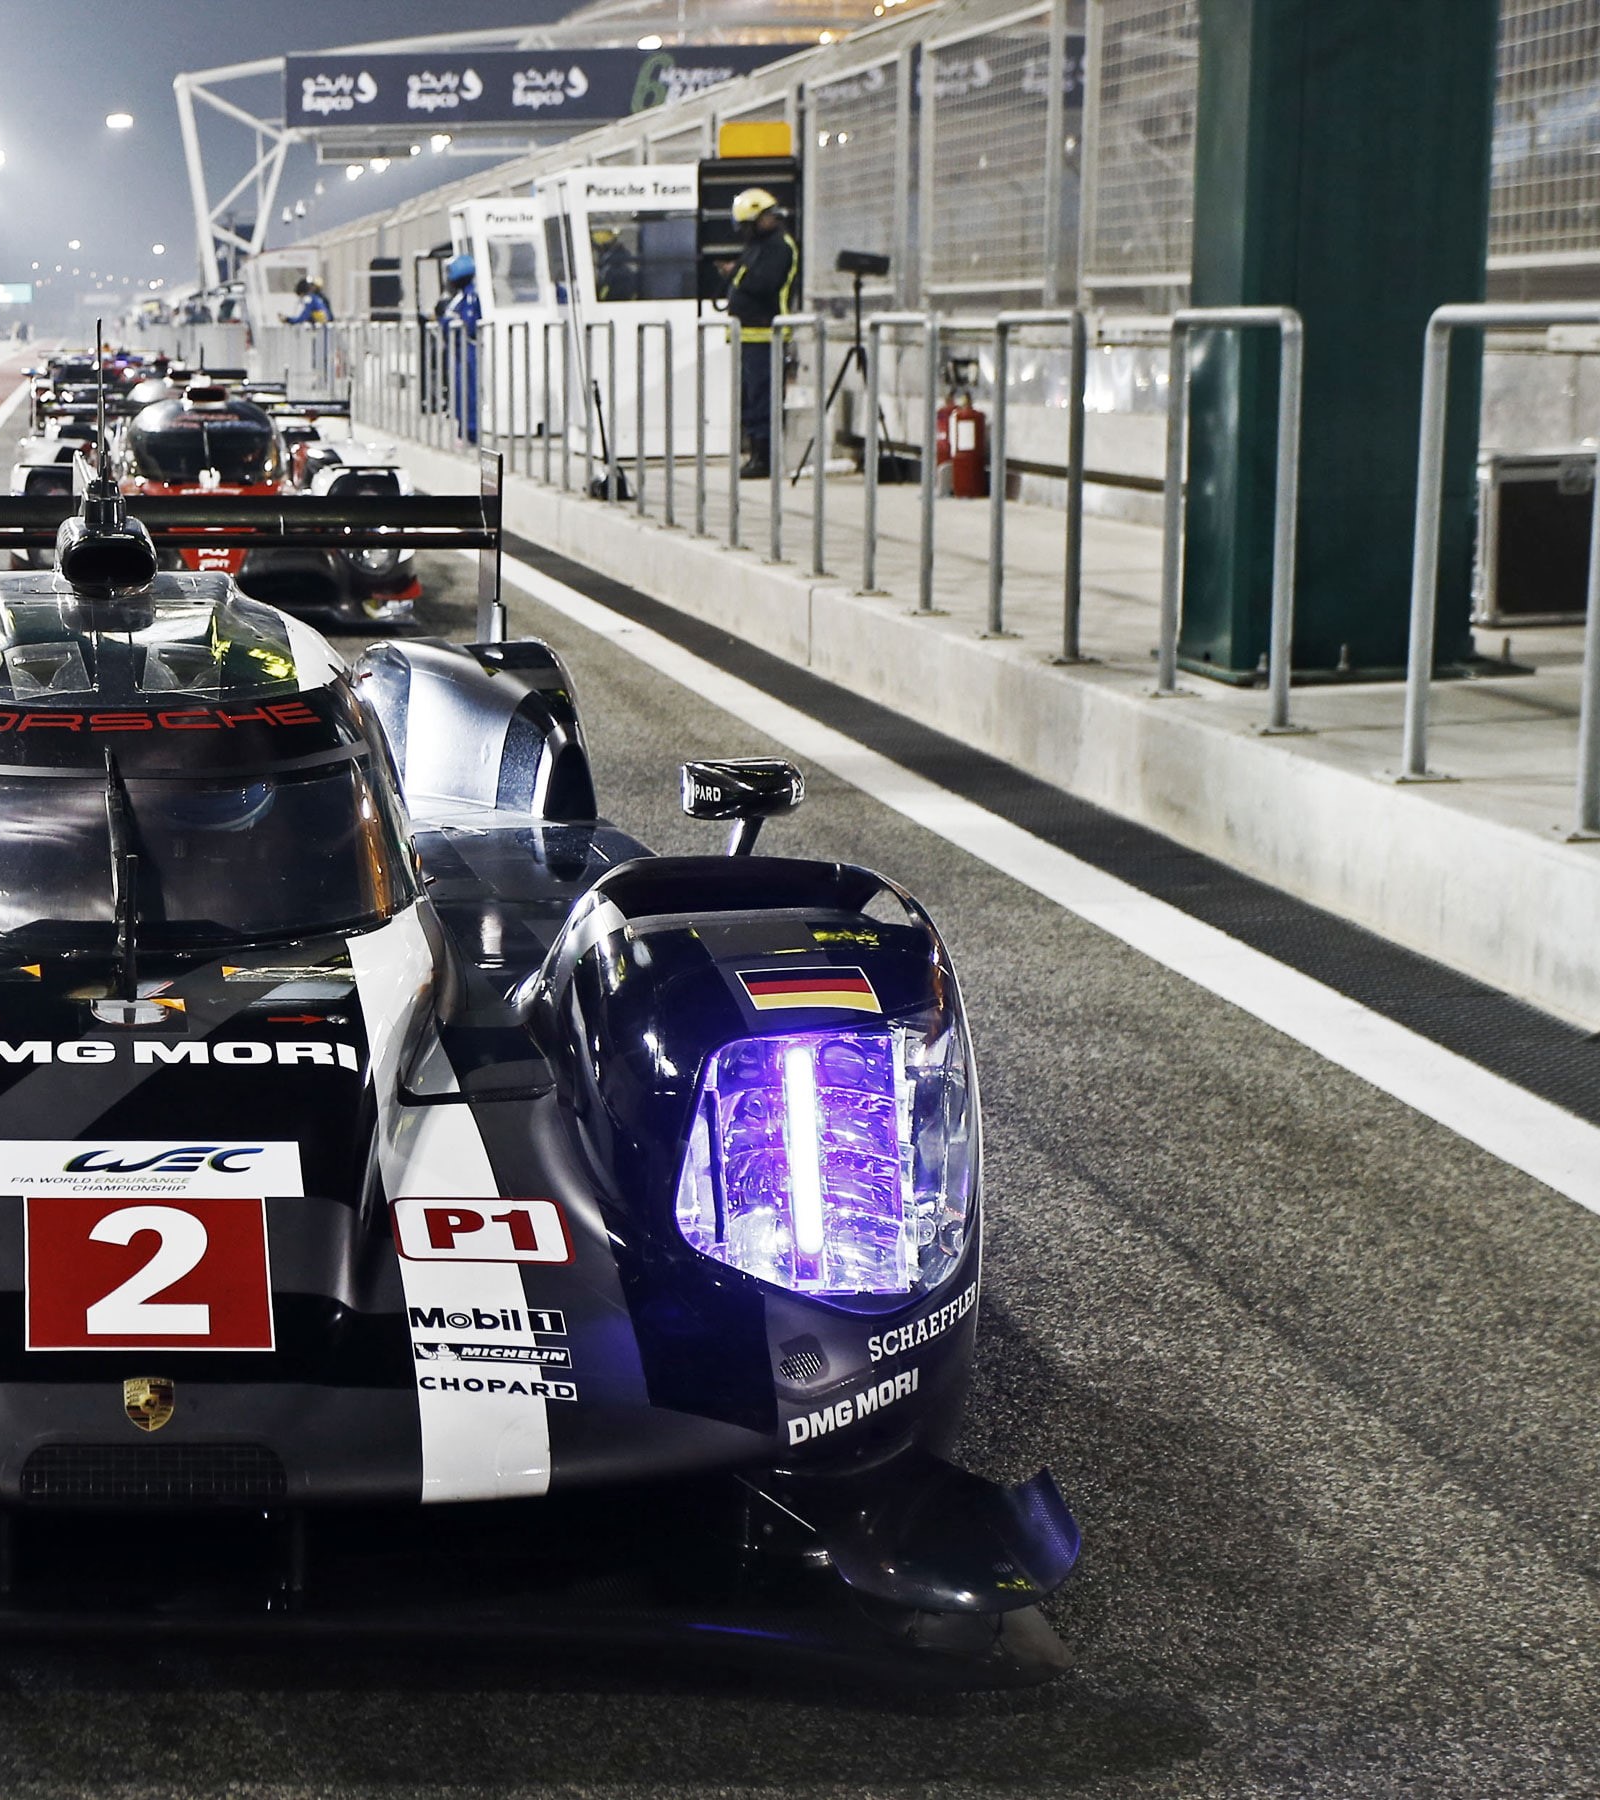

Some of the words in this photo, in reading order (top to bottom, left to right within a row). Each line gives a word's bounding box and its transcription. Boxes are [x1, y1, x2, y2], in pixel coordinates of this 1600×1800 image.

[586, 183, 645, 197] Porsche
[653, 182, 691, 195] Team
[133, 1040, 358, 1072] MORI
[63, 1146, 265, 1173] WEC
[11, 1176, 35, 1184] FIA
[40, 1176, 92, 1184] WORLD
[94, 1176, 191, 1184] ENDURANCE
[72, 1184, 186, 1192] CHAMPIONSHIP
[423, 1208, 539, 1251] P1
[86, 1205, 210, 1335] 2
[409, 1307, 522, 1331] Mobil
[867, 1281, 978, 1363] SCHAEFFLER
[461, 1347, 566, 1362] MICHELIN
[419, 1376, 575, 1399] CHOPARD
[787, 1400, 854, 1446] DMG
[855, 1366, 919, 1420] MORI
